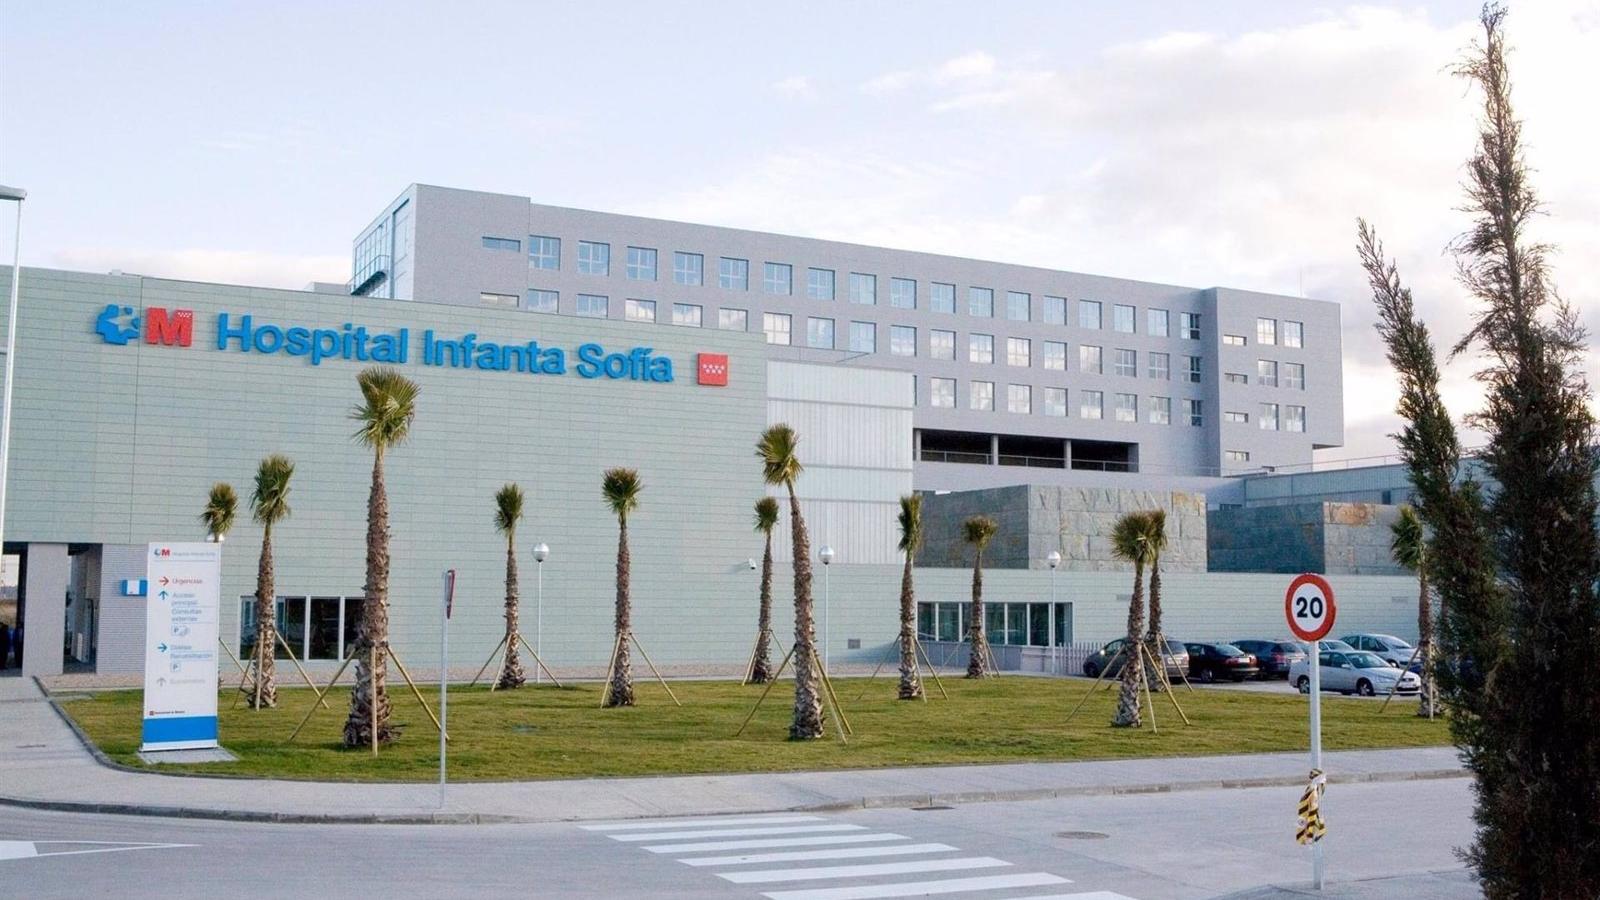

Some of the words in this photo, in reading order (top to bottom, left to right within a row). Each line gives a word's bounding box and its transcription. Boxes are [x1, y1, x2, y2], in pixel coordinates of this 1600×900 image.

[146, 307, 193, 347] M
[217, 313, 409, 366] Hospital
[423, 329, 566, 375] Infanta
[577, 343, 674, 384] Sofía
[1296, 596, 1323, 619] 20
